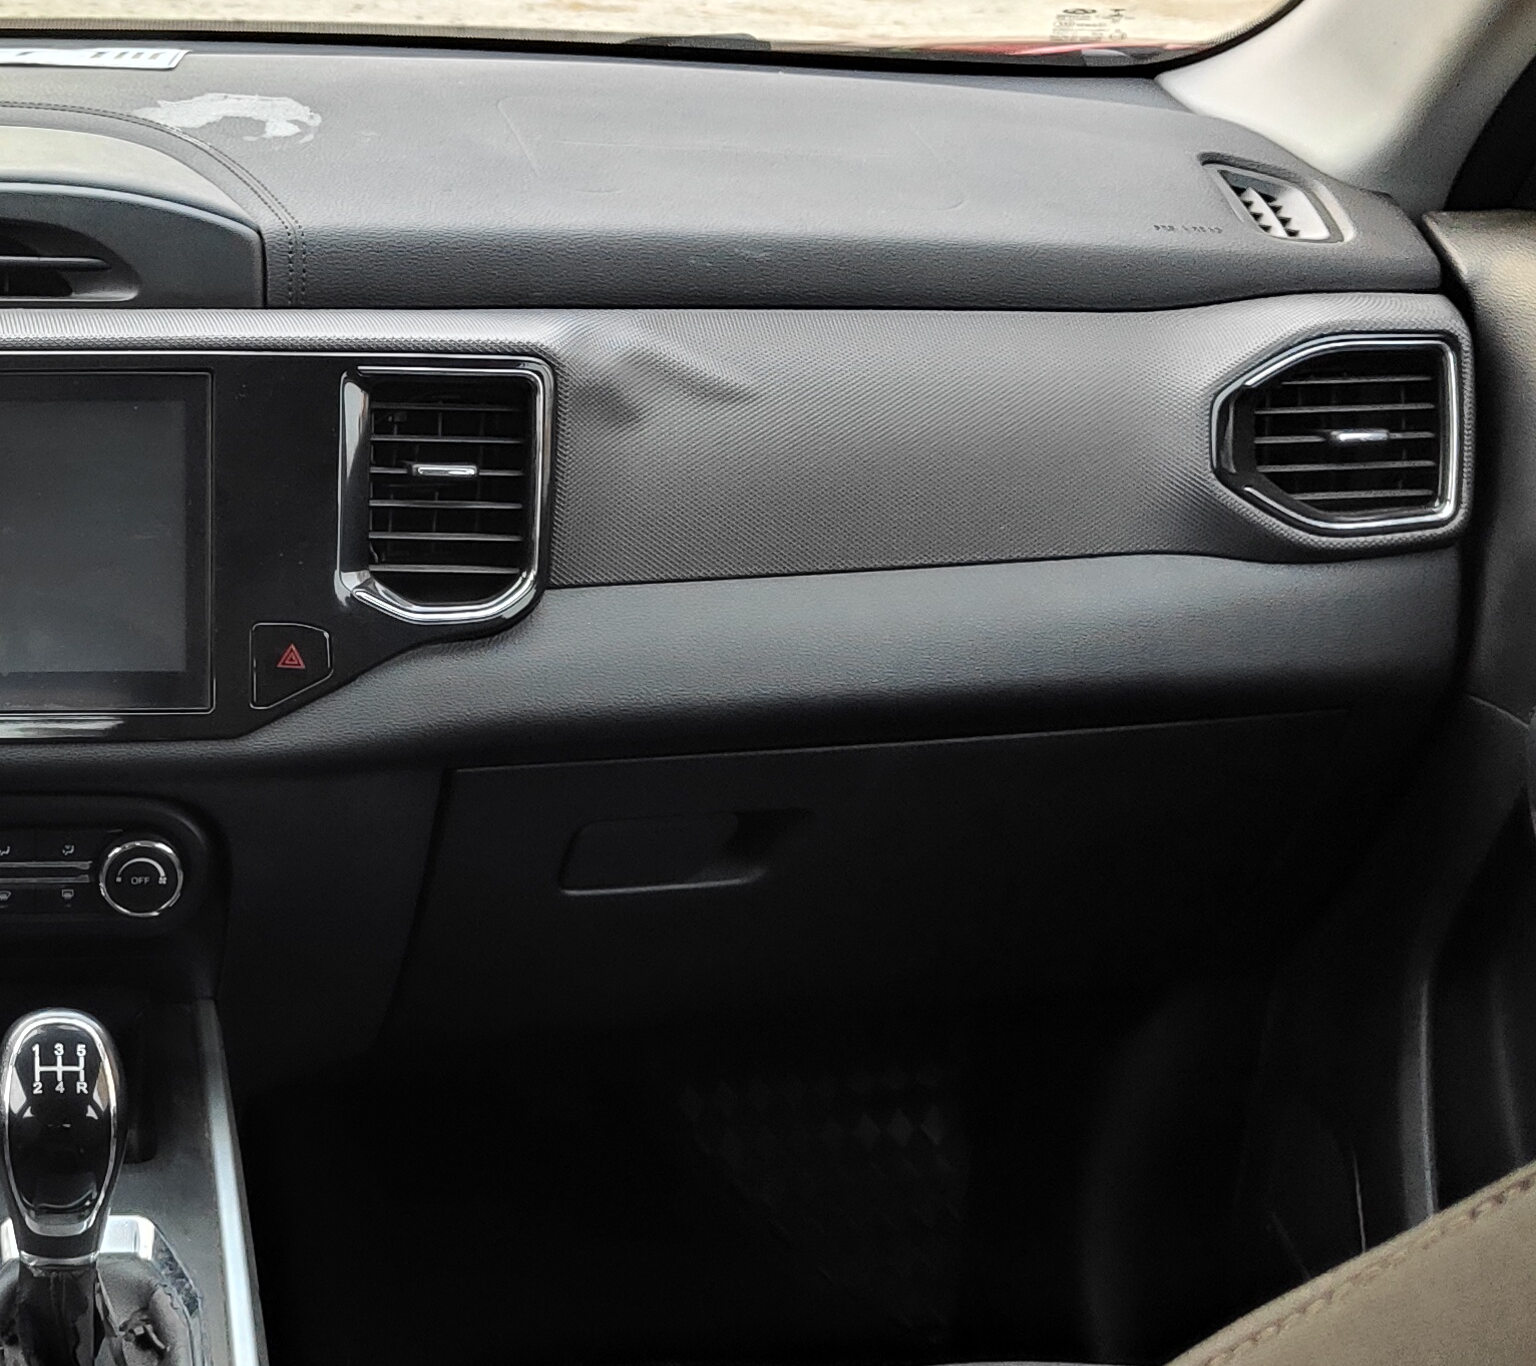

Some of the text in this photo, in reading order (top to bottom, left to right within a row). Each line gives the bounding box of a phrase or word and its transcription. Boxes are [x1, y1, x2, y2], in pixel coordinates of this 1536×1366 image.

[130, 876, 151, 885] OFF
[31, 1042, 87, 1057] 1 3 5
[32, 1081, 88, 1095] 2 4 R
